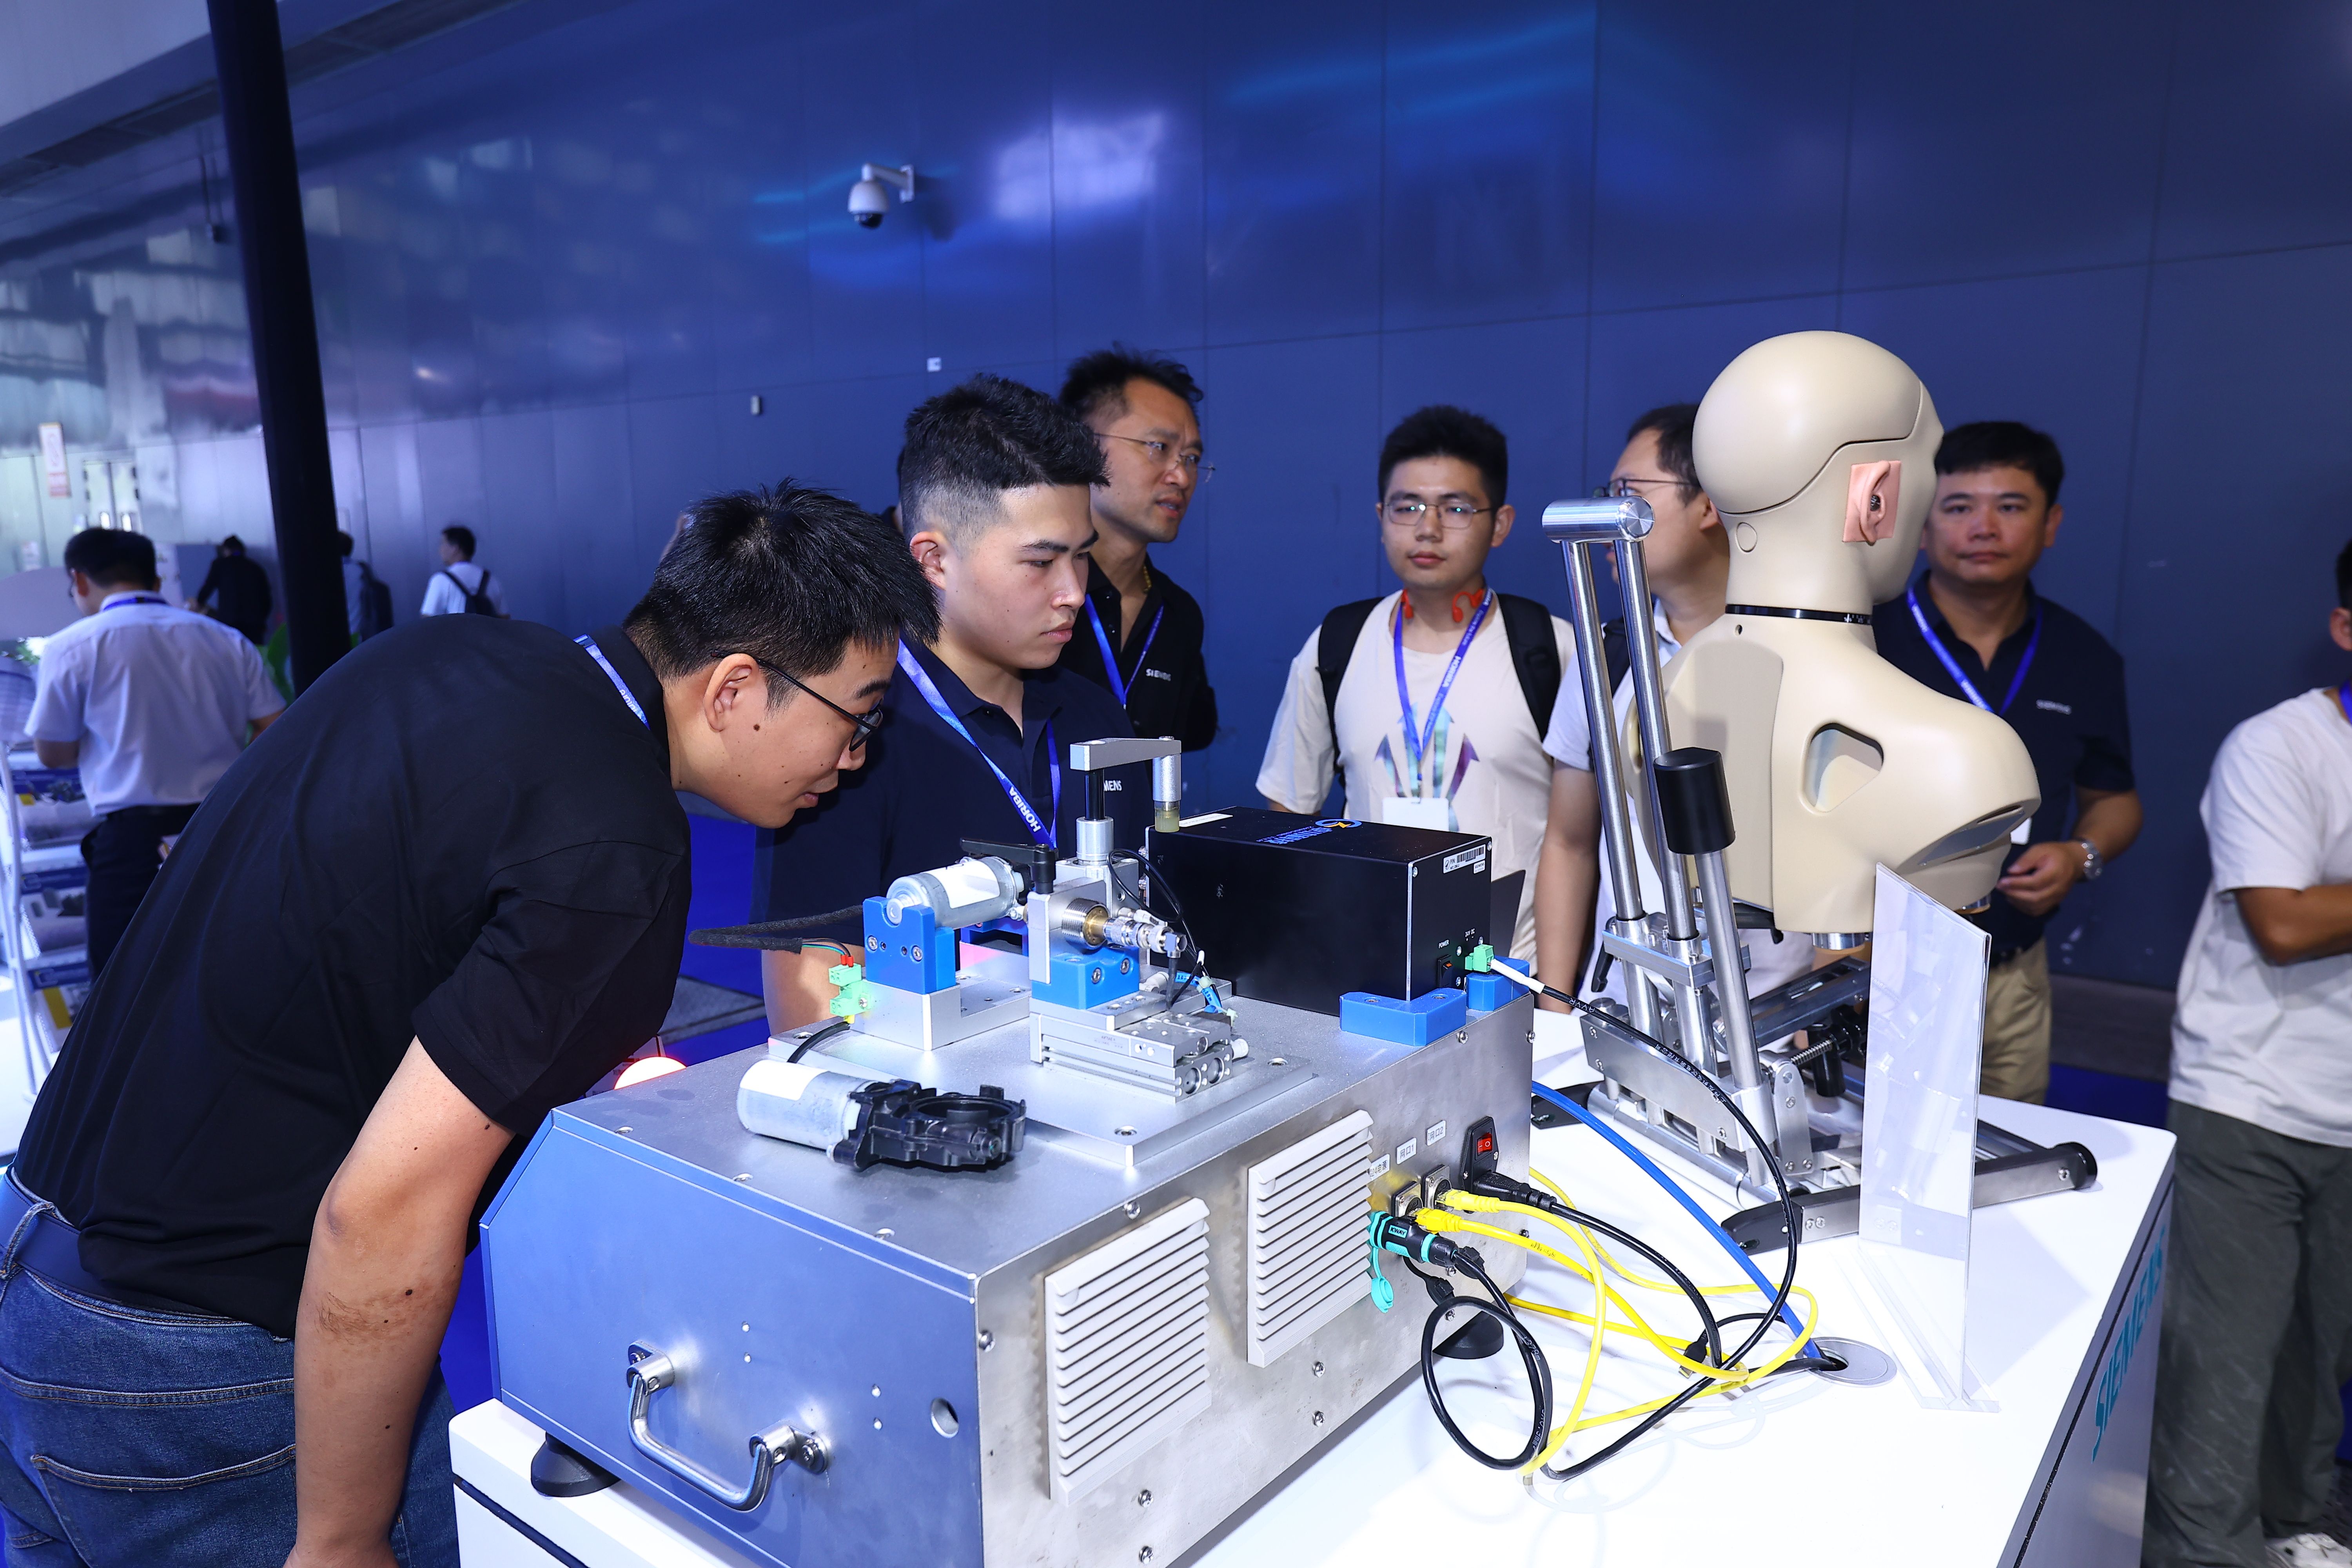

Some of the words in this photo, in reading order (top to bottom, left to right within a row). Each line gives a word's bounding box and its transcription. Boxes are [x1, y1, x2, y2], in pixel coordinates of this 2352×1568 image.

[1442, 655, 1461, 687] HORIBA
[1104, 780, 1122, 791] MENS
[1009, 786, 1041, 832] HORIBA
[1439, 939, 1449, 949] POWER
[1569, 998, 1595, 1013] AVVR
[1400, 1144, 1414, 1160] 网口1
[1390, 1227, 1406, 1236] KWAY
[2092, 1224, 2165, 1464] SIEMENS
